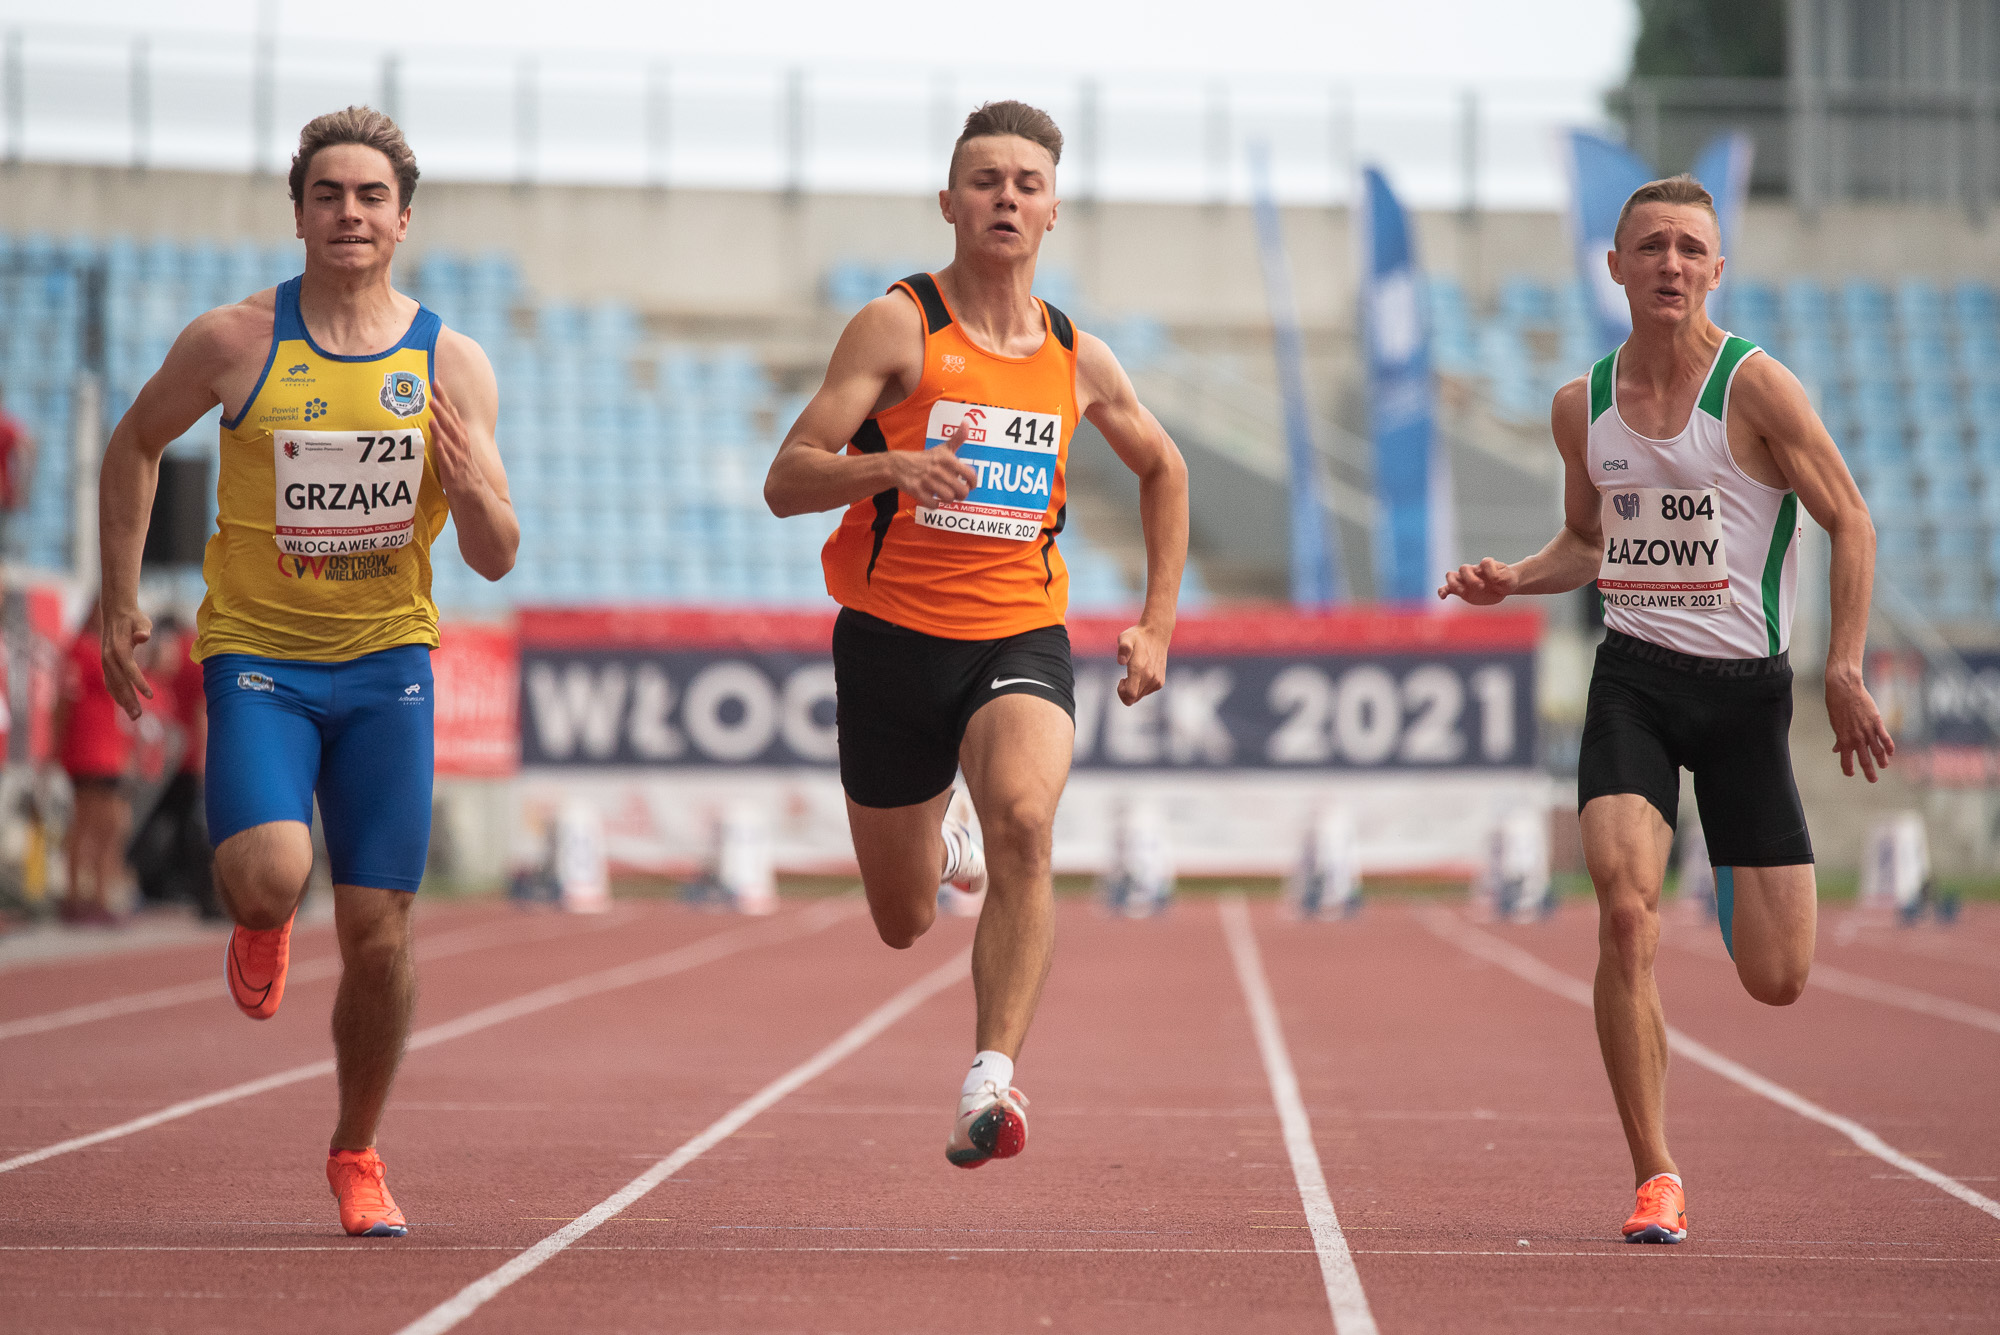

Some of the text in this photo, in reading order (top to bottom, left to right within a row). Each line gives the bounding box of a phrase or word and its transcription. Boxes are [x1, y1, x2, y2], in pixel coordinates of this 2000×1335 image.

[400, 383, 409, 393] S
[260, 415, 299, 423] Ostrowski
[944, 426, 984, 440] OEN
[1005, 416, 1055, 448] 414
[357, 435, 415, 463] 721
[1602, 459, 1629, 471] esa
[284, 480, 412, 515] GRZĄKA
[961, 506, 1010, 516] MISTRZOSTWA
[1011, 511, 1033, 519] POLSKI
[1661, 494, 1714, 521] 804
[318, 527, 374, 535] MISTRZOSTWA
[375, 523, 400, 532] POLSKI
[923, 512, 1036, 538] WŁOCŁAWEK 202
[284, 532, 409, 553] WŁOCŁAWEK 2021
[329, 552, 390, 570] OSTRÓW
[1608, 538, 1719, 566] ŁAZOWY
[325, 565, 397, 581] WIELKOPOLSKI
[1630, 582, 1680, 590] MISTRZOSTWA
[1603, 593, 1722, 607] WŁOCŁAWEK 2021
[1627, 638, 1694, 672] NIKE
[1696, 658, 1759, 677] PRO
[1267, 663, 1517, 764] 2021
